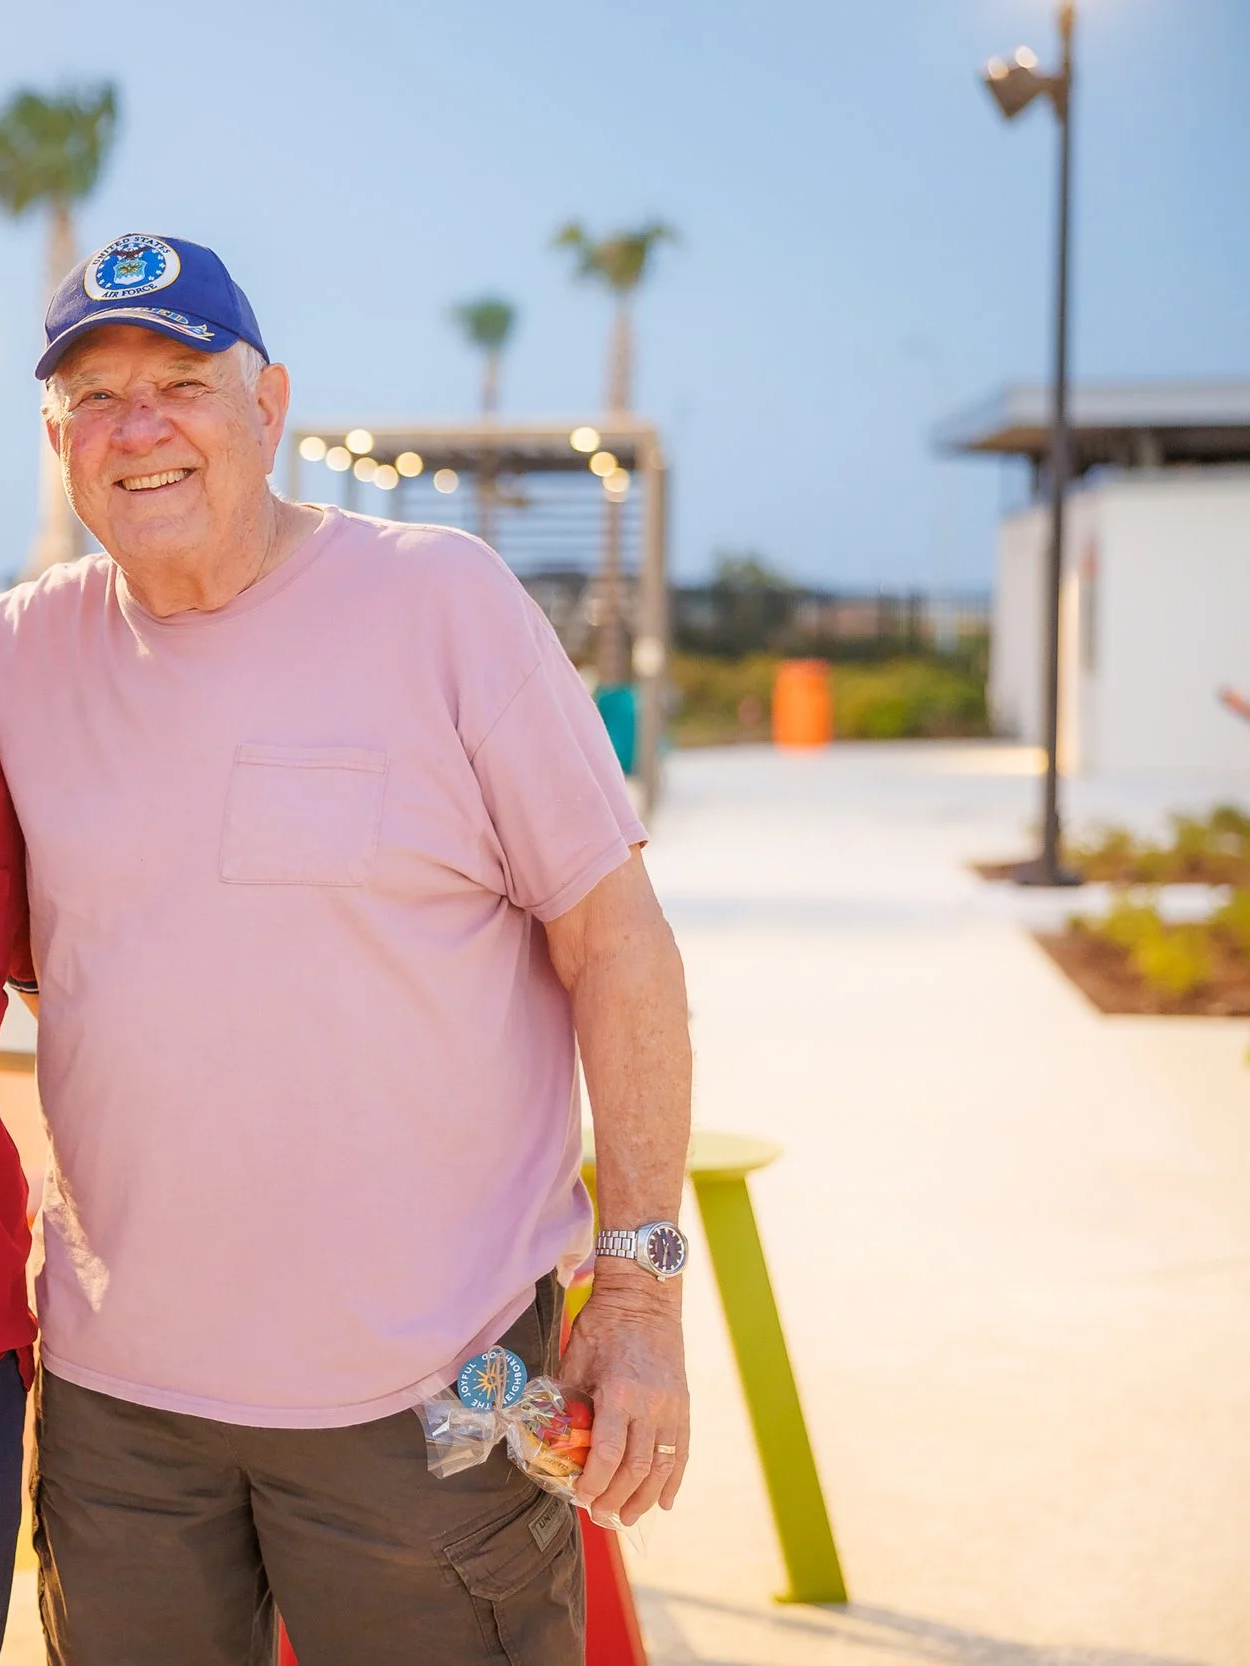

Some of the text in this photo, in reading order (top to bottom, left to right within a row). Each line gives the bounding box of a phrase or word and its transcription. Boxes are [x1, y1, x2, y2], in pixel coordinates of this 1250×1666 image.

[92, 236, 171, 265] UNITED STATES
[121, 283, 157, 296] FORCE
[461, 1363, 490, 1410] THE JOYFUL
[481, 1351, 522, 1405] EIGHBORHOD
